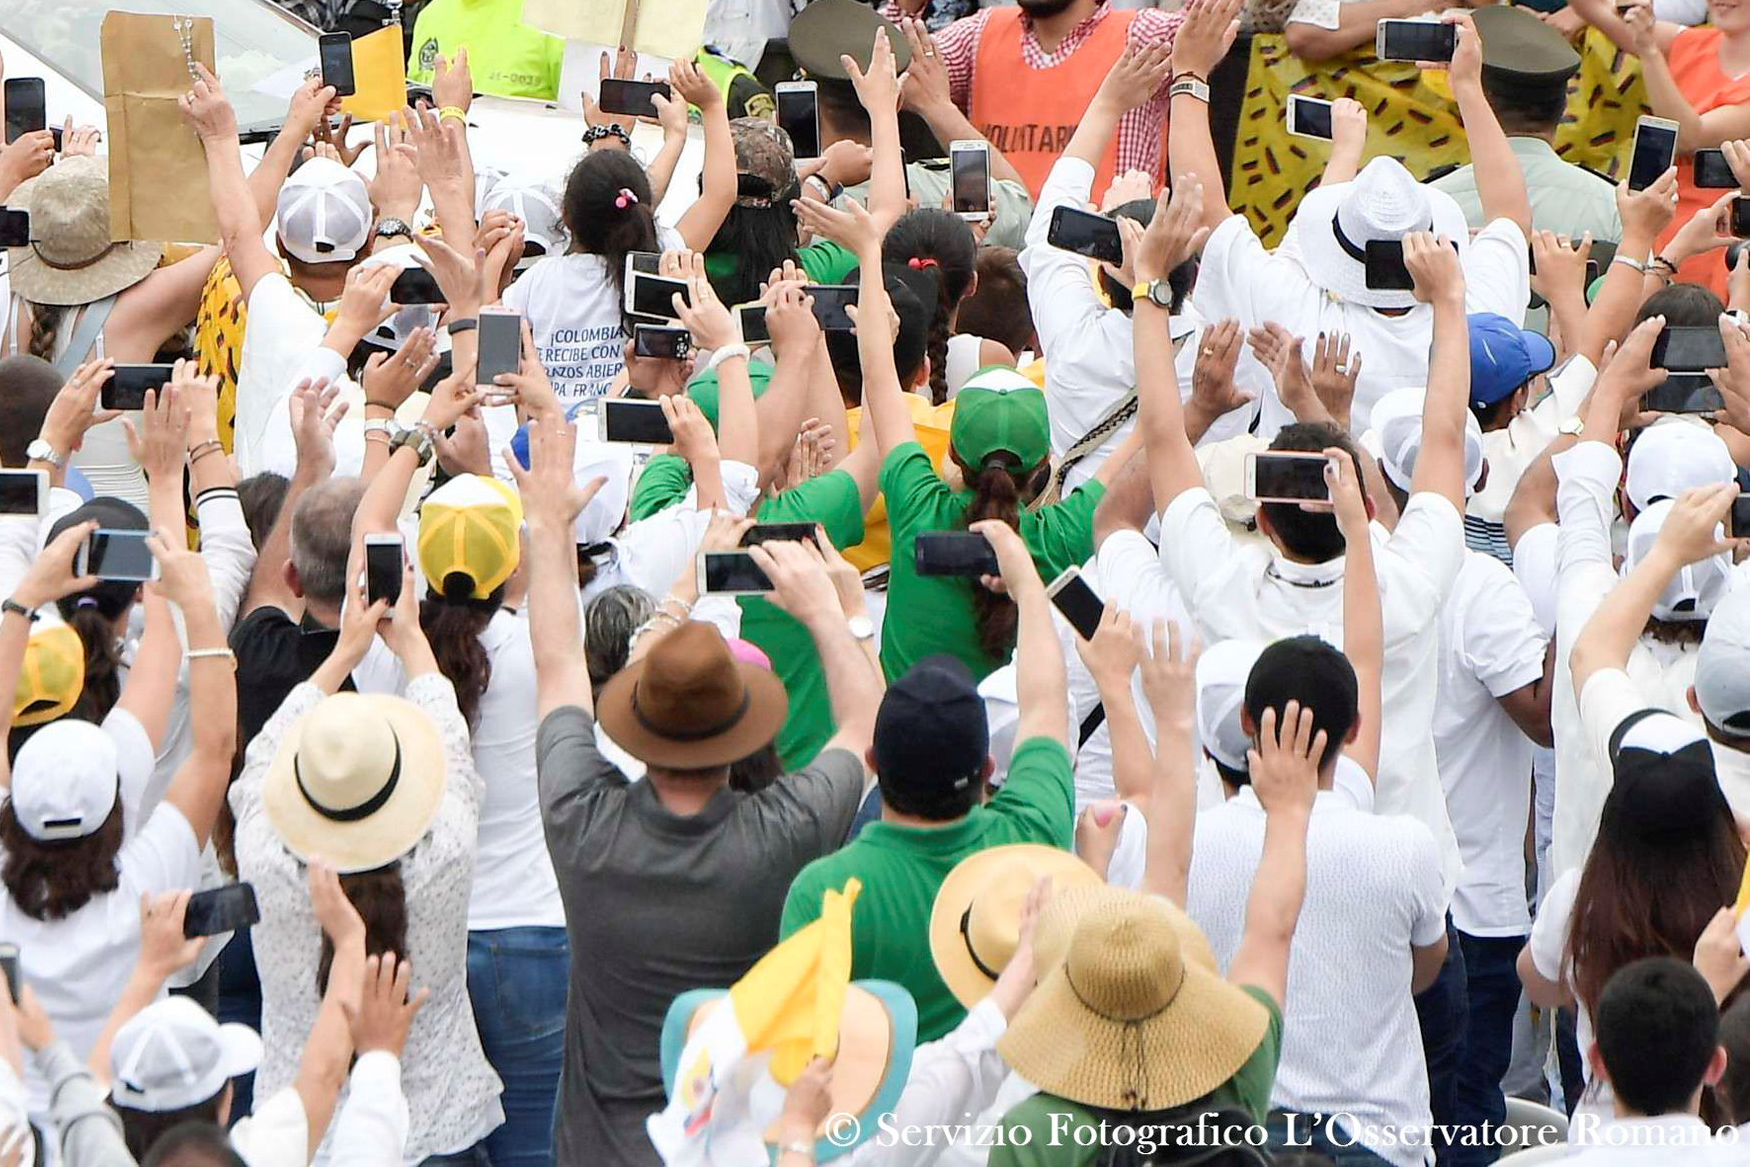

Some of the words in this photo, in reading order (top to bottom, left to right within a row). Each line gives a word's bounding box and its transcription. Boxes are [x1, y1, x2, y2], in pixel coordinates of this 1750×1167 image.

[545, 347, 588, 362] RECIBE
[591, 344, 621, 360] CON
[586, 362, 623, 379] ABIER
